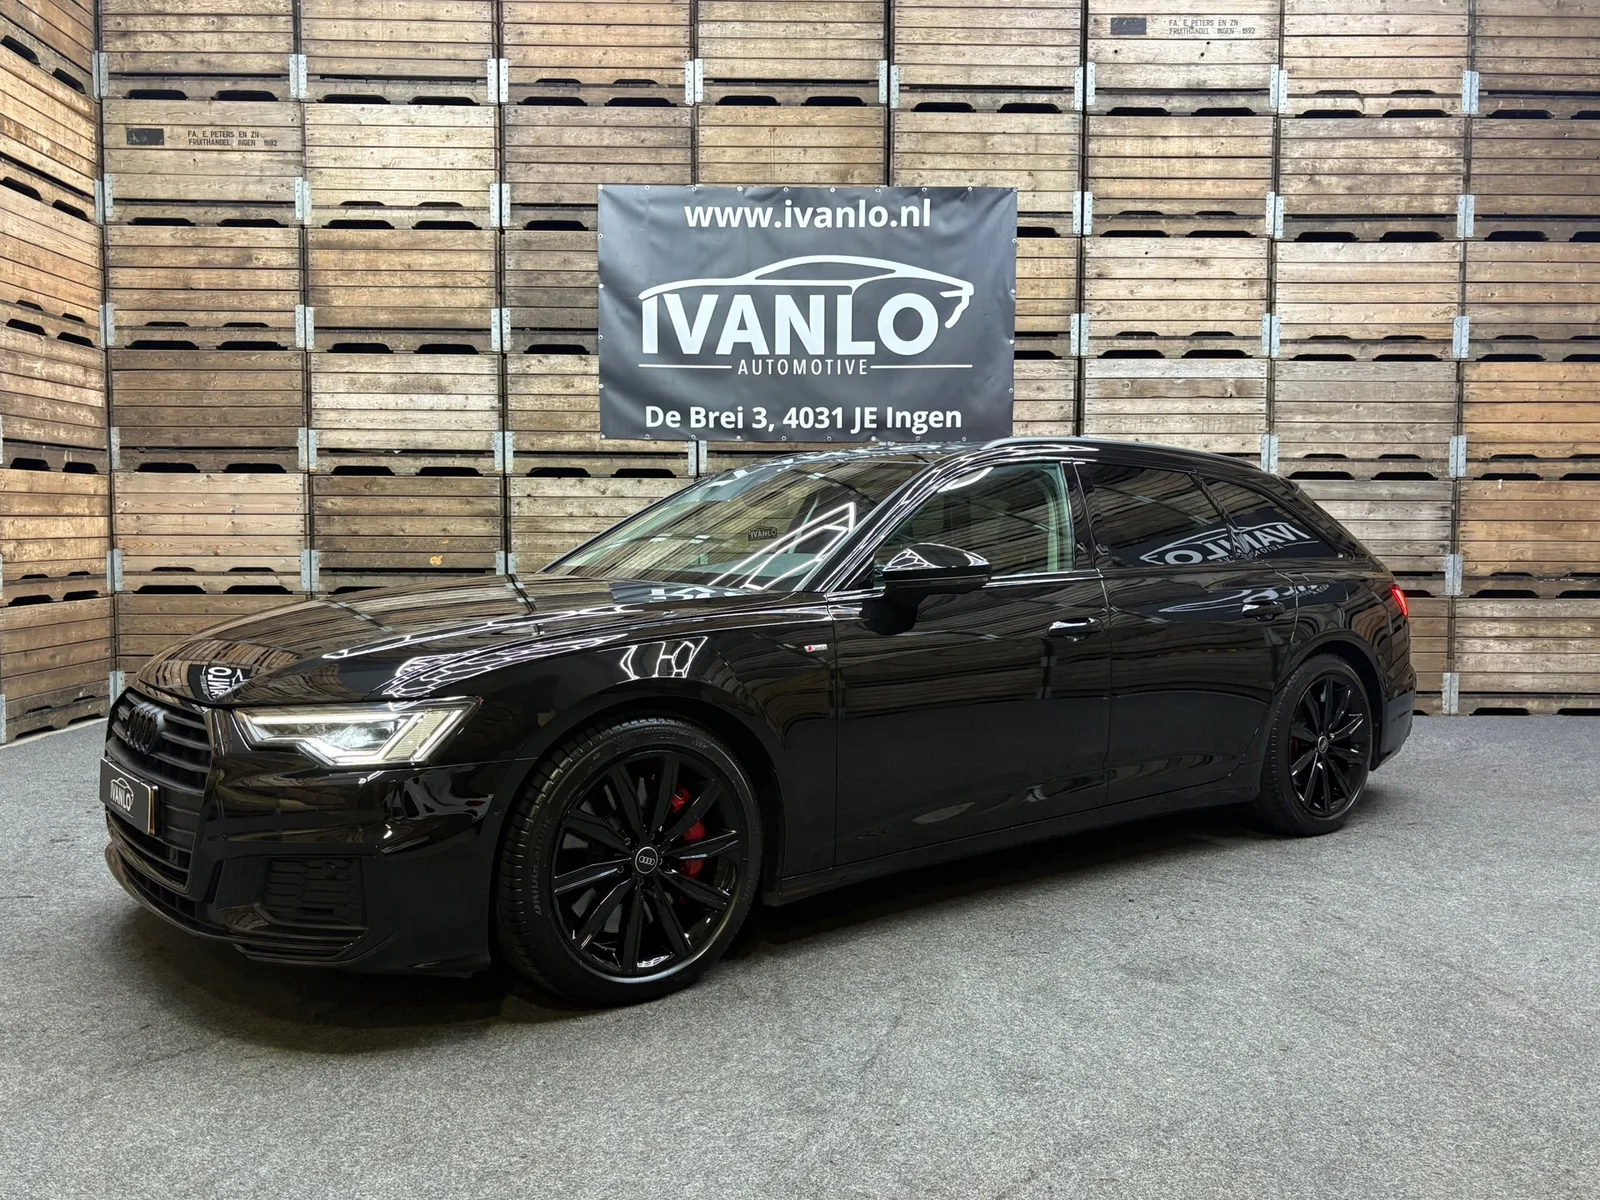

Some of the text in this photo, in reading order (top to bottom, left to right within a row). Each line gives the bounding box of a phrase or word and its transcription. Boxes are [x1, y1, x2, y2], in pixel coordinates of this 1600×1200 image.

[1169, 27, 1210, 35] FRUITHANDEL
[1191, 19, 1214, 27] PETERS
[1218, 19, 1227, 27] EN
[187, 130, 199, 138] FA.
[210, 130, 235, 138] PETERS
[238, 131, 248, 139] EN
[188, 138, 231, 147] FRUITHANDEL
[238, 139, 256, 147] INGEN
[684, 198, 932, 229] www.ivanlo.nl
[642, 292, 939, 356] IVANLO
[737, 359, 868, 376] AUTOMOTIVE
[645, 405, 962, 435] De Brei 3, 4031 JE Ingen
[110, 781, 132, 812] IVANLO
